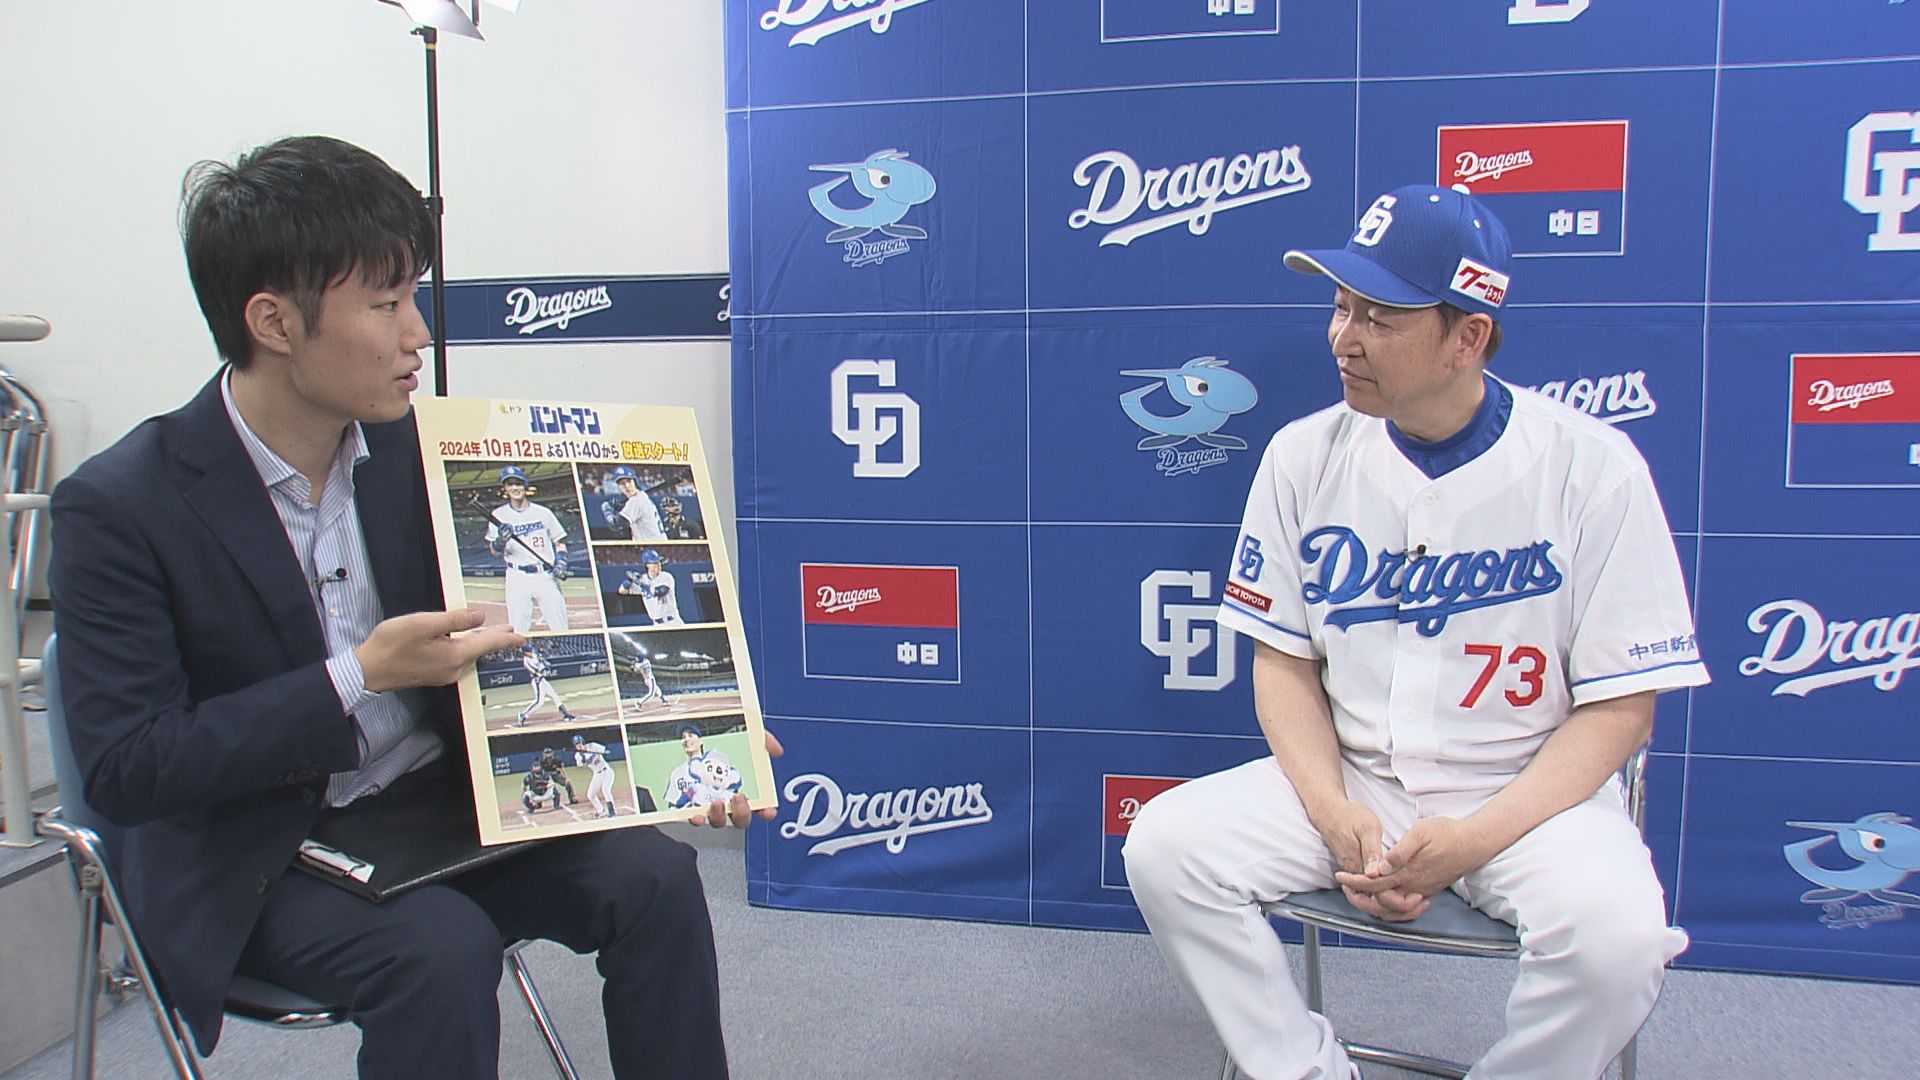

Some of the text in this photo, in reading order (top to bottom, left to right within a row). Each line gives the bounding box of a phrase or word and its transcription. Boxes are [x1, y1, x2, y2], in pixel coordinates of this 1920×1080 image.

[1454, 149, 1534, 183] Dragons
[1068, 145, 1311, 248] Dragons
[1547, 209, 1600, 237] 中日
[843, 236, 910, 268] Dragons
[504, 284, 613, 336] Dragons
[1807, 379, 1896, 412] Dragons
[529, 404, 602, 435] バントマン
[1155, 447, 1228, 477] Dragons
[1301, 525, 1563, 638] Dragons
[816, 584, 882, 613] Dragons
[1240, 589, 1266, 608] TOYOTA
[896, 640, 940, 666] 中日
[1738, 599, 1920, 698] Drag
[1458, 643, 1547, 709] 73
[780, 772, 993, 857] Dragons
